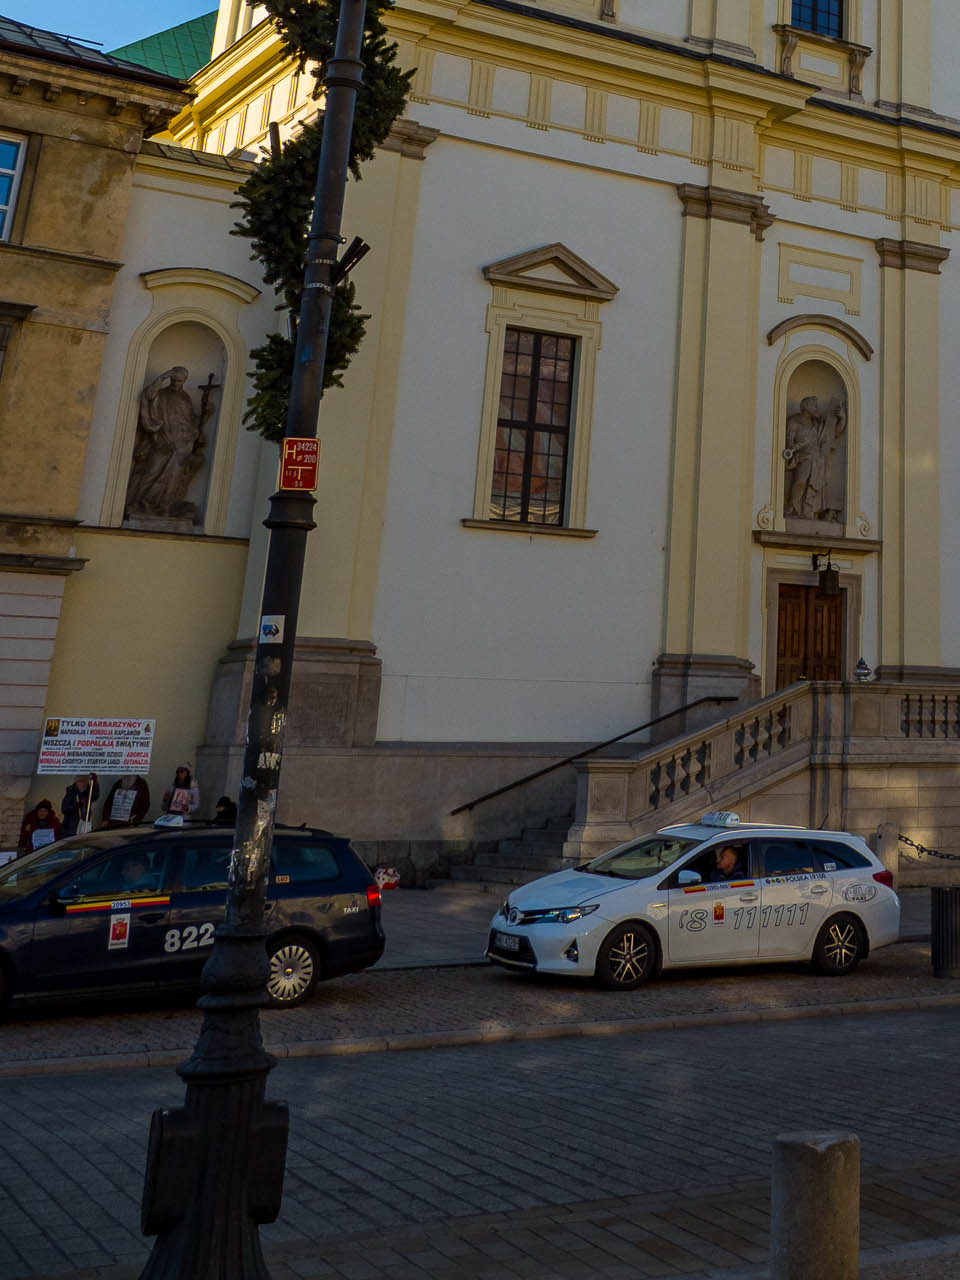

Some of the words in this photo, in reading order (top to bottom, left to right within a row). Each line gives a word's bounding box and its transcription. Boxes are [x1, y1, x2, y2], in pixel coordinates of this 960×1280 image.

[286, 444, 296, 459] H
[297, 442, 317, 451] 34224
[303, 454, 316, 464] 200
[77, 740, 114, 748] PODPALAJĄ
[685, 908, 708, 932] 8
[164, 922, 215, 952] 822
